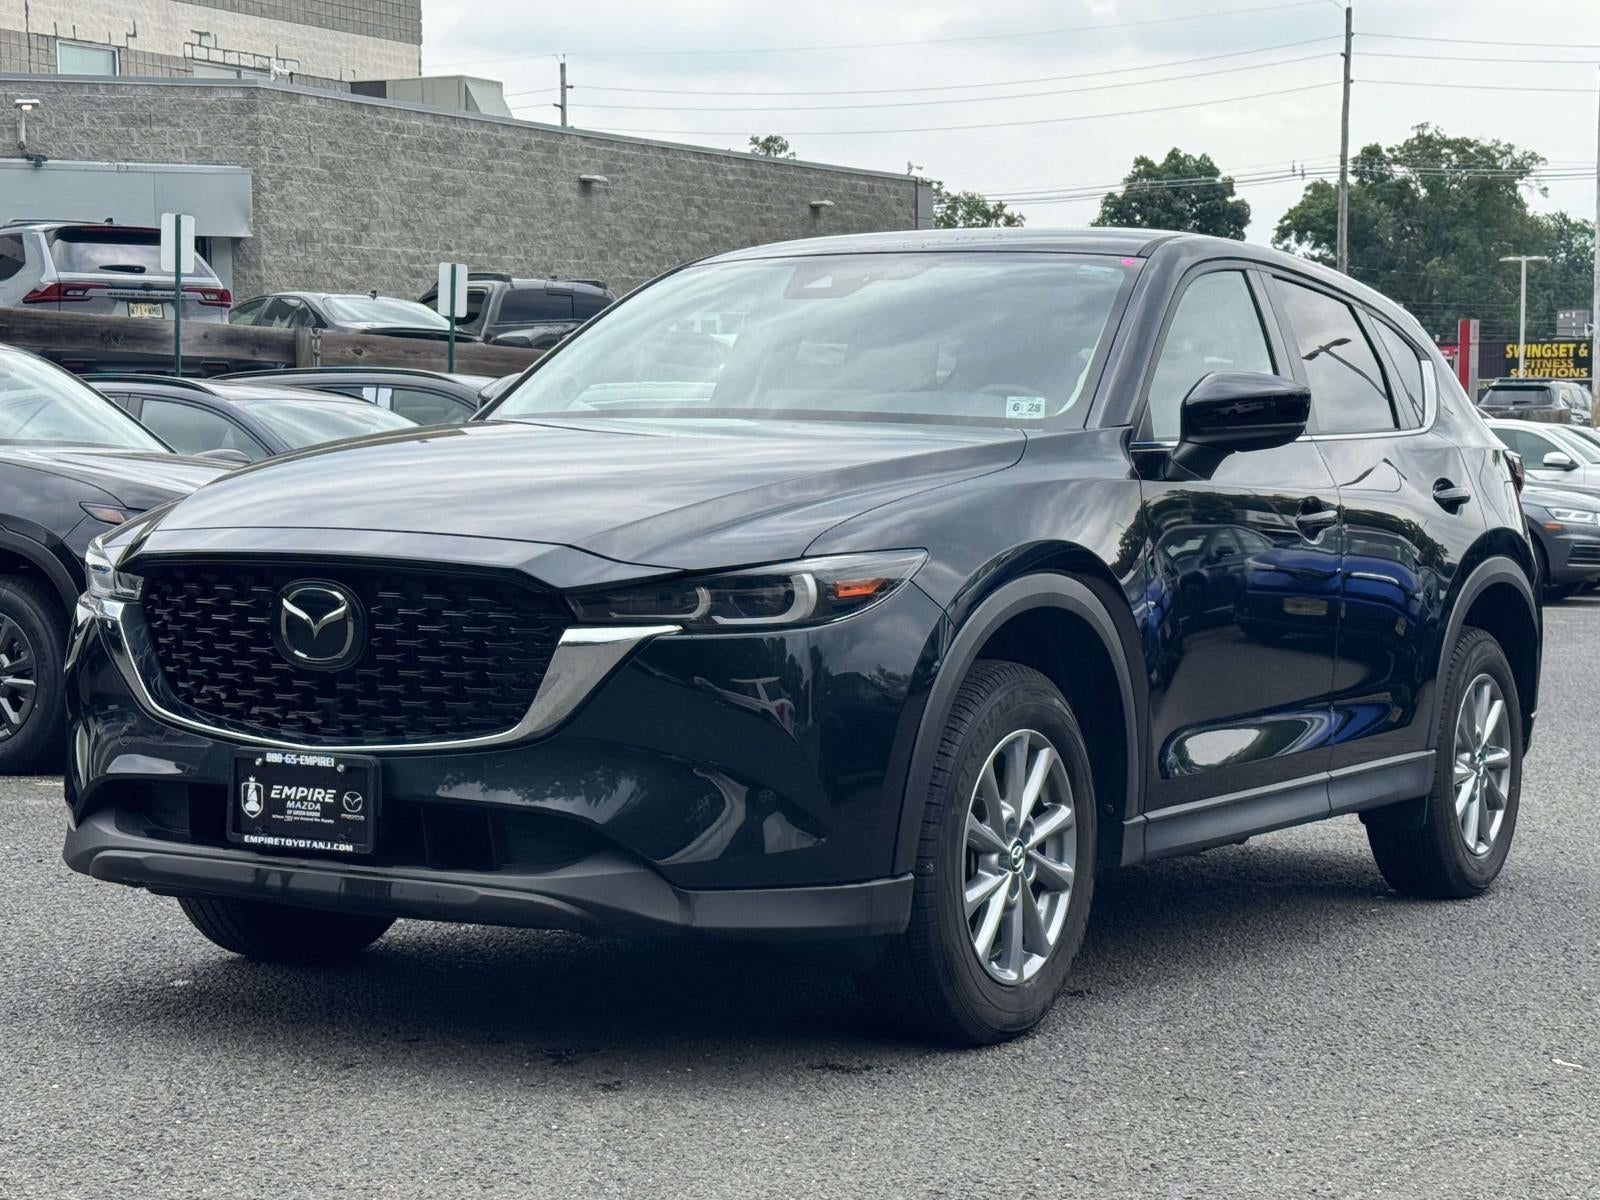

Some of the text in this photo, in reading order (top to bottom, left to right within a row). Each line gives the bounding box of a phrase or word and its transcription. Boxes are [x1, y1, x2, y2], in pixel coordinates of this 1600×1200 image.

[1505, 343, 1589, 358] SWINGSET &
[1524, 359, 1574, 368] FITNESS
[1013, 402, 1041, 412] 6 28
[270, 785, 337, 803] EMPIRE
[287, 801, 321, 811] MAZDA
[244, 834, 353, 852] EMPIRETOYOTANJ.COM
